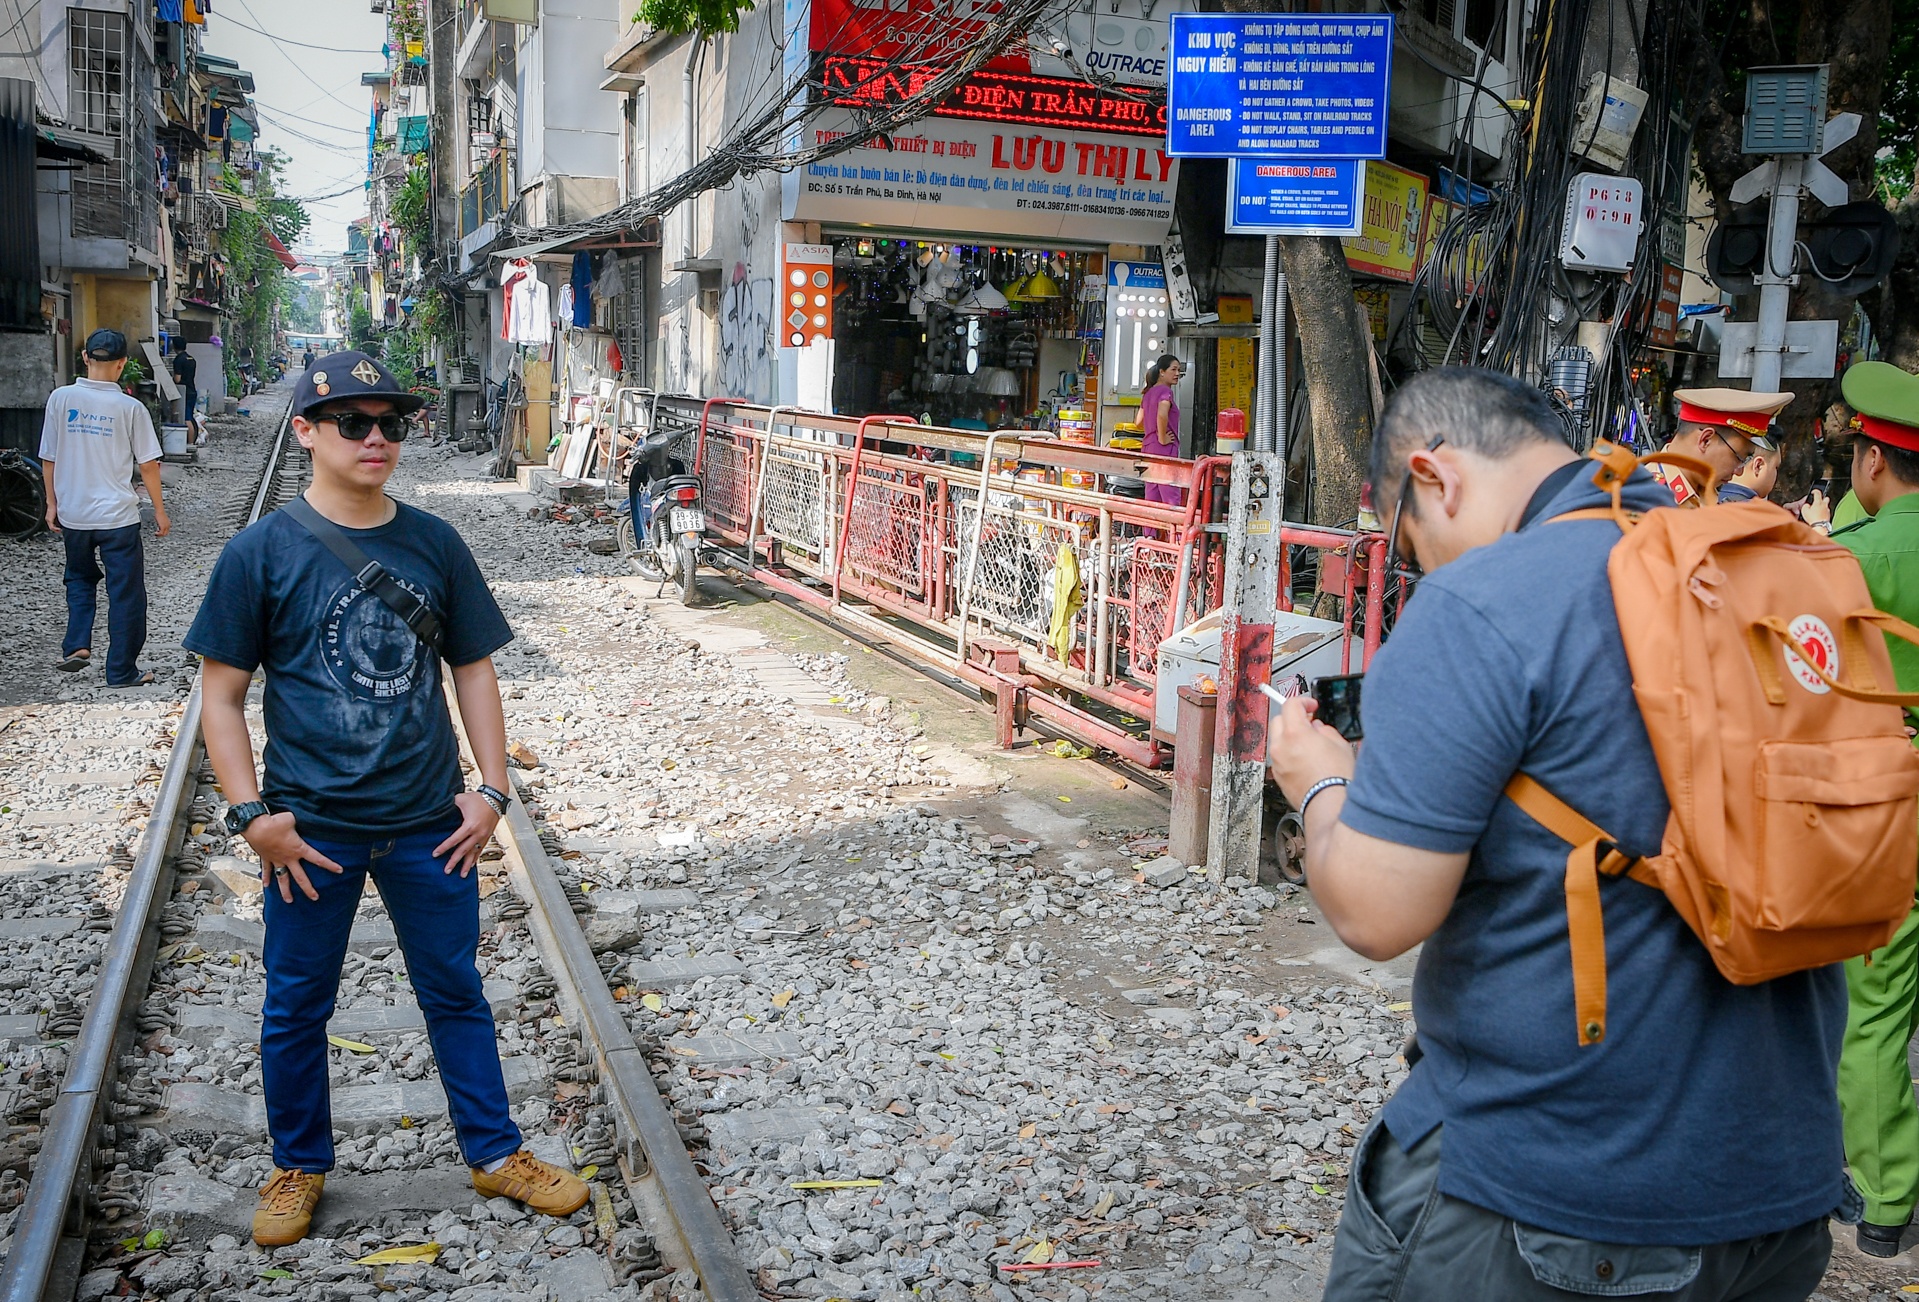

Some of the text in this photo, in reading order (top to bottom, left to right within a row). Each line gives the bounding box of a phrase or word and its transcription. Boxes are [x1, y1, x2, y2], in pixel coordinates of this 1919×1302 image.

[1245, 22, 1264, 36] KHÔNG
[1322, 25, 1337, 37] QUAY
[1338, 25, 1354, 37] PHIM,
[1372, 21, 1384, 36] ẢNH
[1188, 31, 1236, 51] KHU VỰC
[1244, 41, 1263, 54] KHÔNG
[1306, 41, 1321, 54] TRÊN
[1342, 40, 1353, 54] SẮT
[1085, 51, 1165, 76] OUTRACE
[1176, 51, 1237, 73] NGUY HIỂM
[1243, 59, 1262, 73] KHÔNG
[1340, 61, 1359, 73] TRONG
[1248, 79, 1259, 91] HAI
[1259, 77, 1272, 91] BÊN
[1292, 76, 1304, 91] SẮT
[964, 85, 1025, 112] ĐIỆN
[1243, 97, 1374, 108] DO NOT GATHER A CROWD, TAKE PHOTOS, VIDEOS
[1176, 108, 1232, 122] DANGEROUS
[1242, 111, 1372, 121] DO NOT WALK, STAND, SIT ON RAILROAD TRACKS
[1189, 124, 1215, 137] AREA
[1242, 125, 1375, 135] DO NOT DISPLAY CHAIRS, TABLES AND PEDDLE ON
[893, 134, 928, 153] THIẾT
[932, 140, 944, 157] BỊ
[950, 140, 977, 159] ĐIỆN
[1238, 139, 1320, 148] AND ALONG RAILROAD TRACKS
[991, 134, 1176, 186] LƯU THỊ LY
[1256, 165, 1337, 178] DANGEROUS AREA
[807, 162, 838, 180] Chuyên
[841, 165, 858, 179] bán
[860, 166, 881, 181] buôn
[884, 168, 899, 183] bán
[929, 171, 947, 187] điện
[949, 173, 966, 188] dân
[968, 175, 990, 192] dụng,
[993, 179, 1009, 191] đèn
[1011, 179, 1025, 192] led
[1027, 179, 1049, 194] chiếu
[1052, 182, 1073, 198] sáng,
[1077, 184, 1092, 197] đèn
[1095, 187, 1117, 202] trang
[1120, 187, 1130, 200] trí
[1132, 188, 1146, 201] các
[808, 181, 942, 203] ĐC: Số 5 Trần Phú, Ba Đình, Hà Nội
[1240, 196, 1251, 205] DO
[1252, 196, 1267, 205] NOT
[1383, 196, 1402, 238] NỘI
[1134, 267, 1164, 277] OUTRAC
[81, 413, 115, 423] VNPT
[677, 520, 700, 530] 9036
[375, 680, 390, 689] THE
[390, 674, 409, 688] LAST
[374, 689, 396, 697] SINCE
